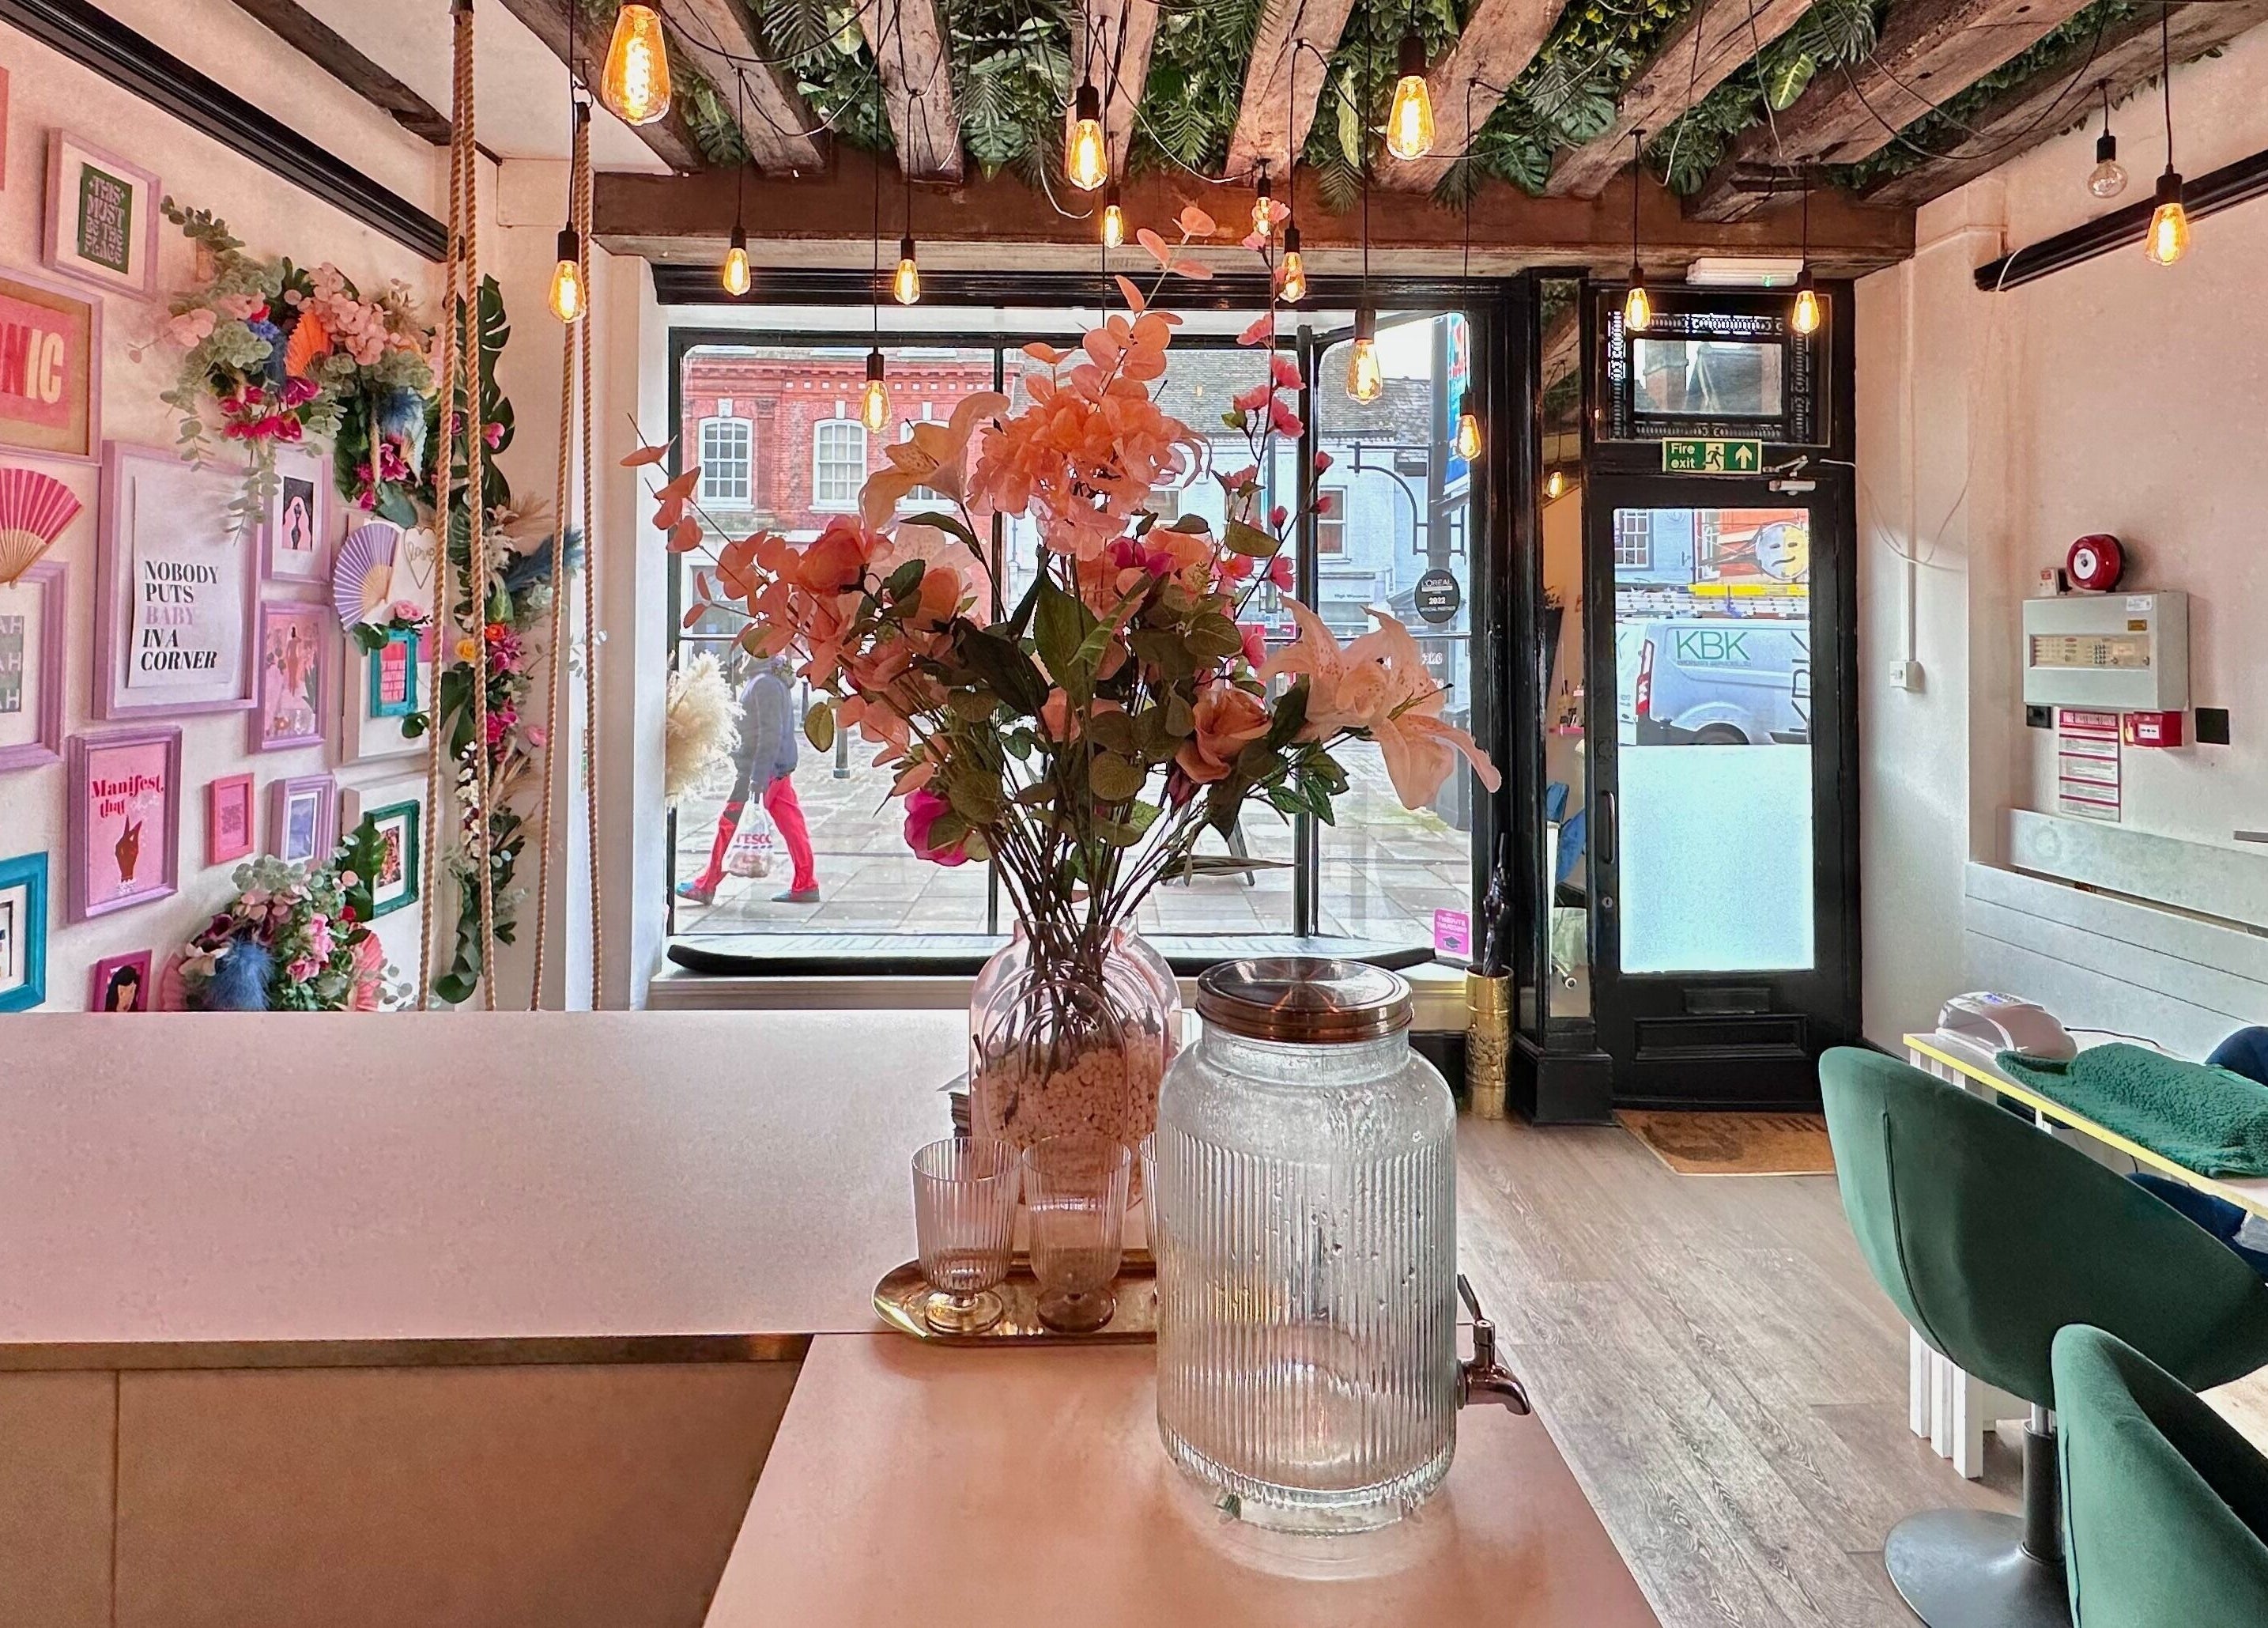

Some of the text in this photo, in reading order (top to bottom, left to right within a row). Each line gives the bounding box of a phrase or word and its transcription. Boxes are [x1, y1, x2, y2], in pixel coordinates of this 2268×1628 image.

[92, 176, 121, 206] THIS
[86, 193, 125, 229] MUST
[85, 214, 123, 247] BE THE
[84, 232, 123, 265] PLACE
[0, 322, 65, 404] NIC
[1671, 443, 1696, 455] Fire
[1670, 456, 1696, 469] exit
[145, 561, 219, 584] NOBODY
[145, 583, 194, 603] PUTS
[1428, 596, 1446, 605] 2022
[145, 606, 194, 625] BABY
[143, 629, 179, 648] IN A
[1676, 630, 1750, 660] KBK
[141, 651, 217, 671] CORNER
[100, 799, 125, 818] that
